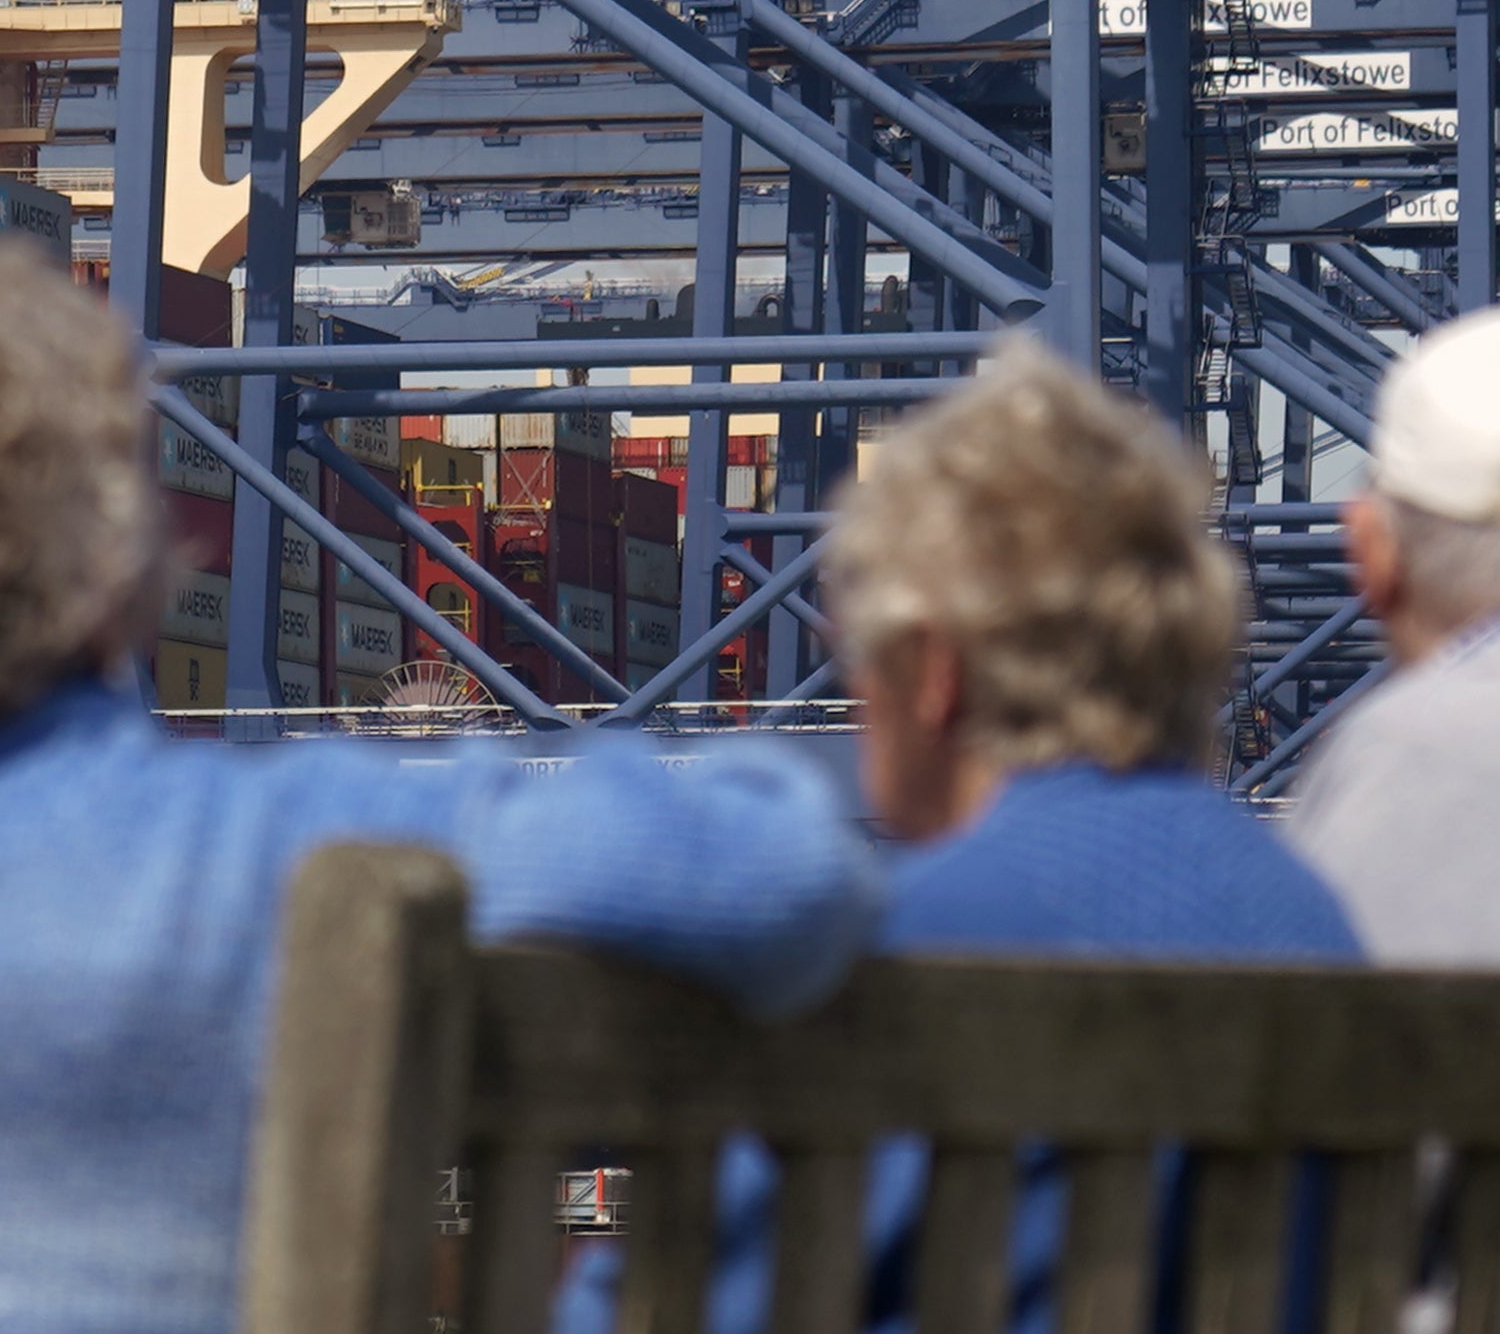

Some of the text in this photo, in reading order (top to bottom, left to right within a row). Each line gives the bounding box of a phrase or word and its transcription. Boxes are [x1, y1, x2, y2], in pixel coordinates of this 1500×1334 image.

[1262, 59, 1404, 88] Felixstowe
[1263, 116, 1458, 144] Port of Felixsto
[1386, 192, 1436, 217] Port
[352, 624, 393, 656] MAERSK
